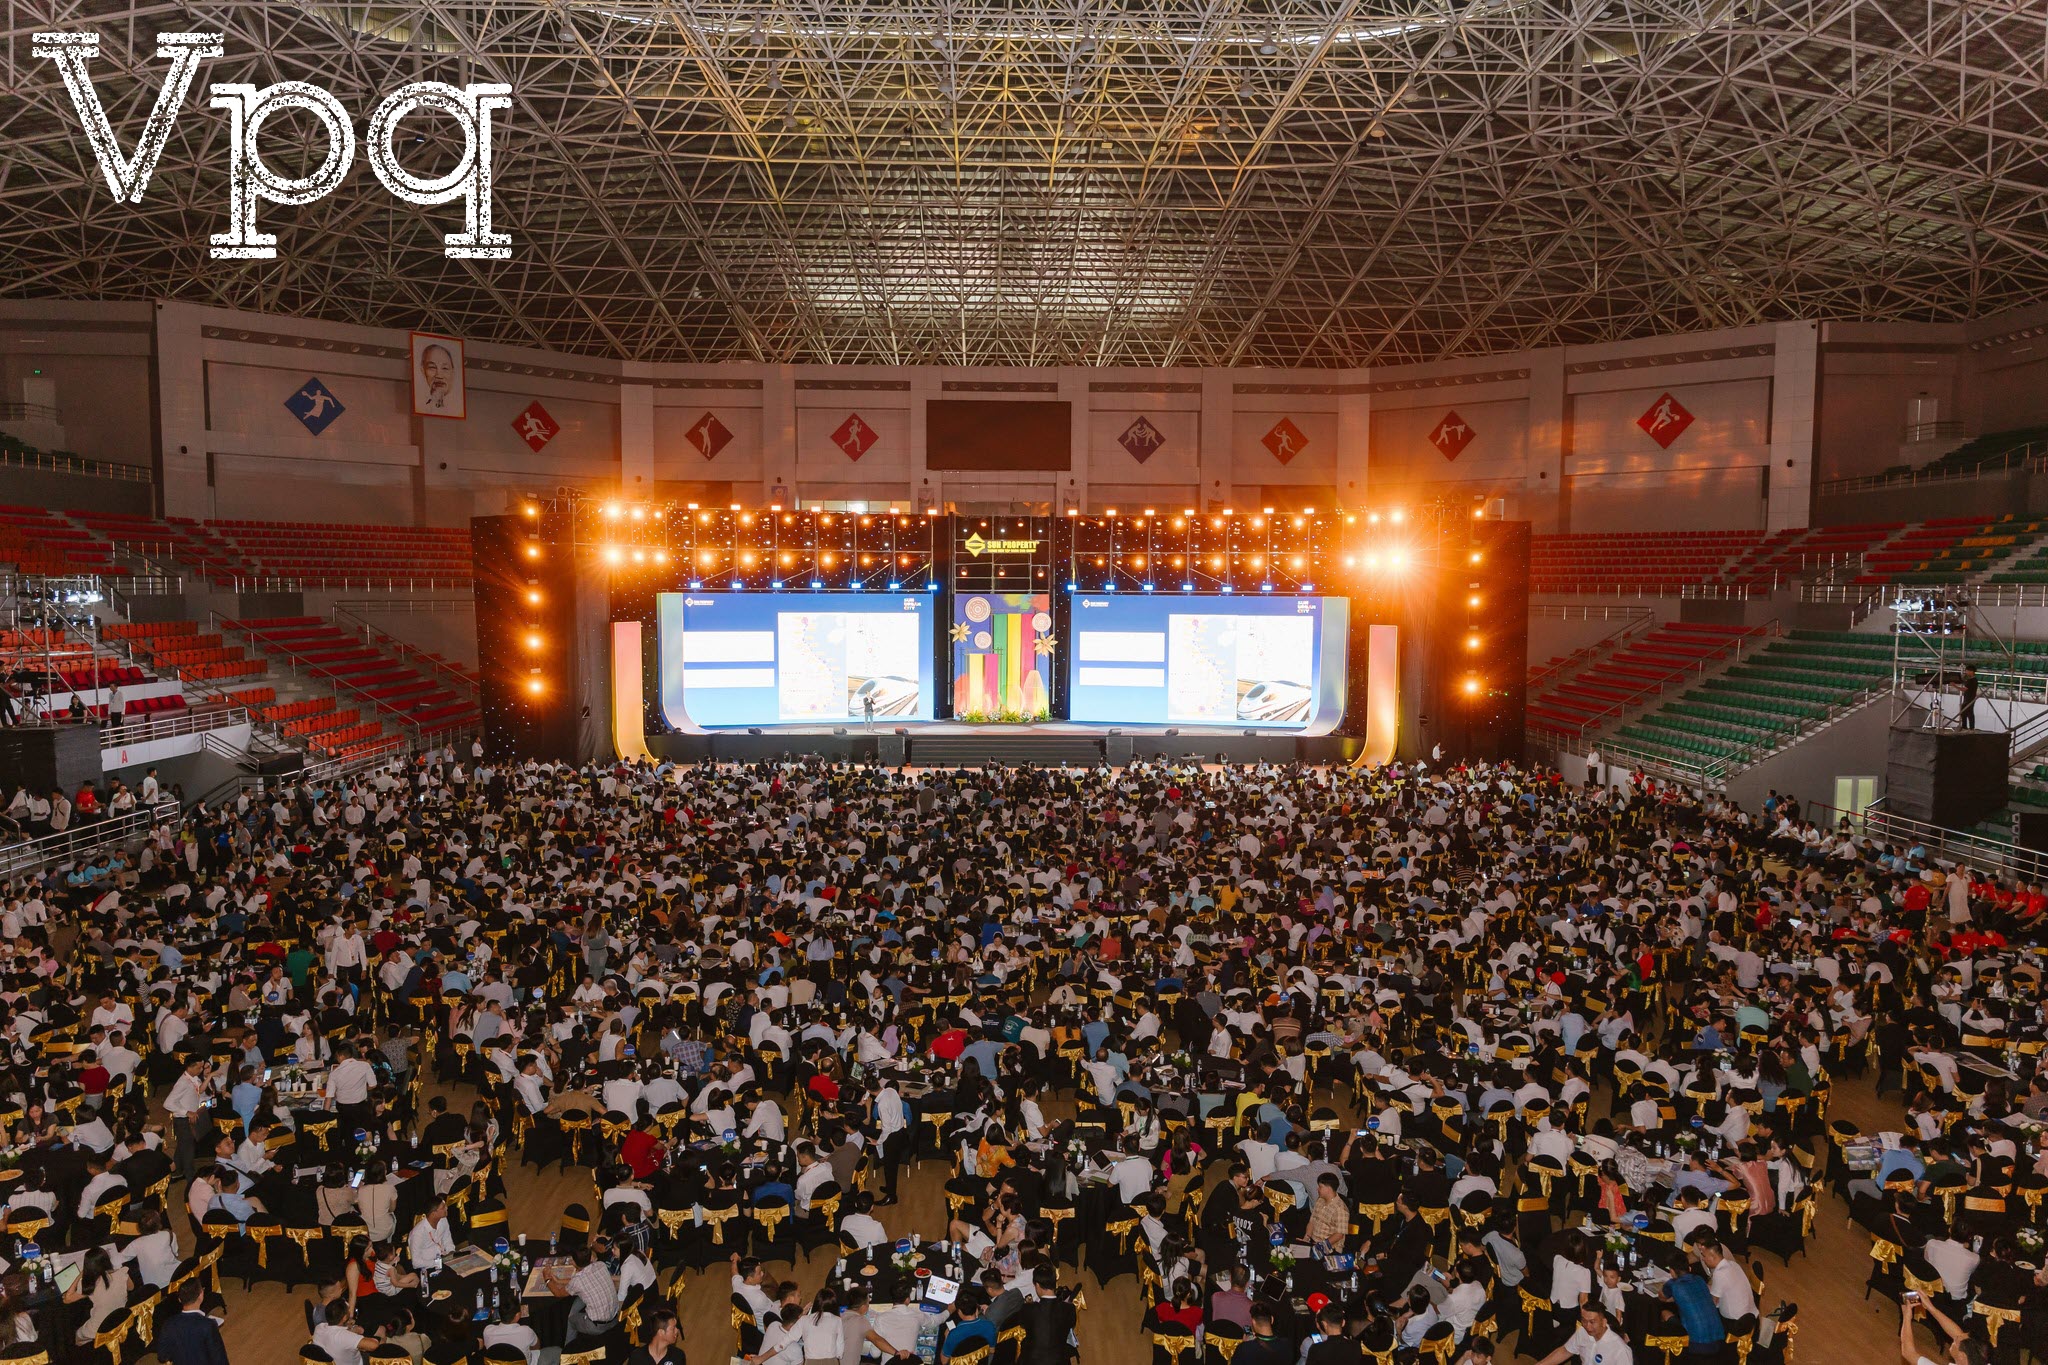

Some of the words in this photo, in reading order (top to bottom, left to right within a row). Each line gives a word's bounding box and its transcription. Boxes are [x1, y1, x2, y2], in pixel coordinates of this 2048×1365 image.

[987, 540, 1002, 549] SUN
[1003, 540, 1037, 549] PROPERTY
[121, 750, 128, 764] A
